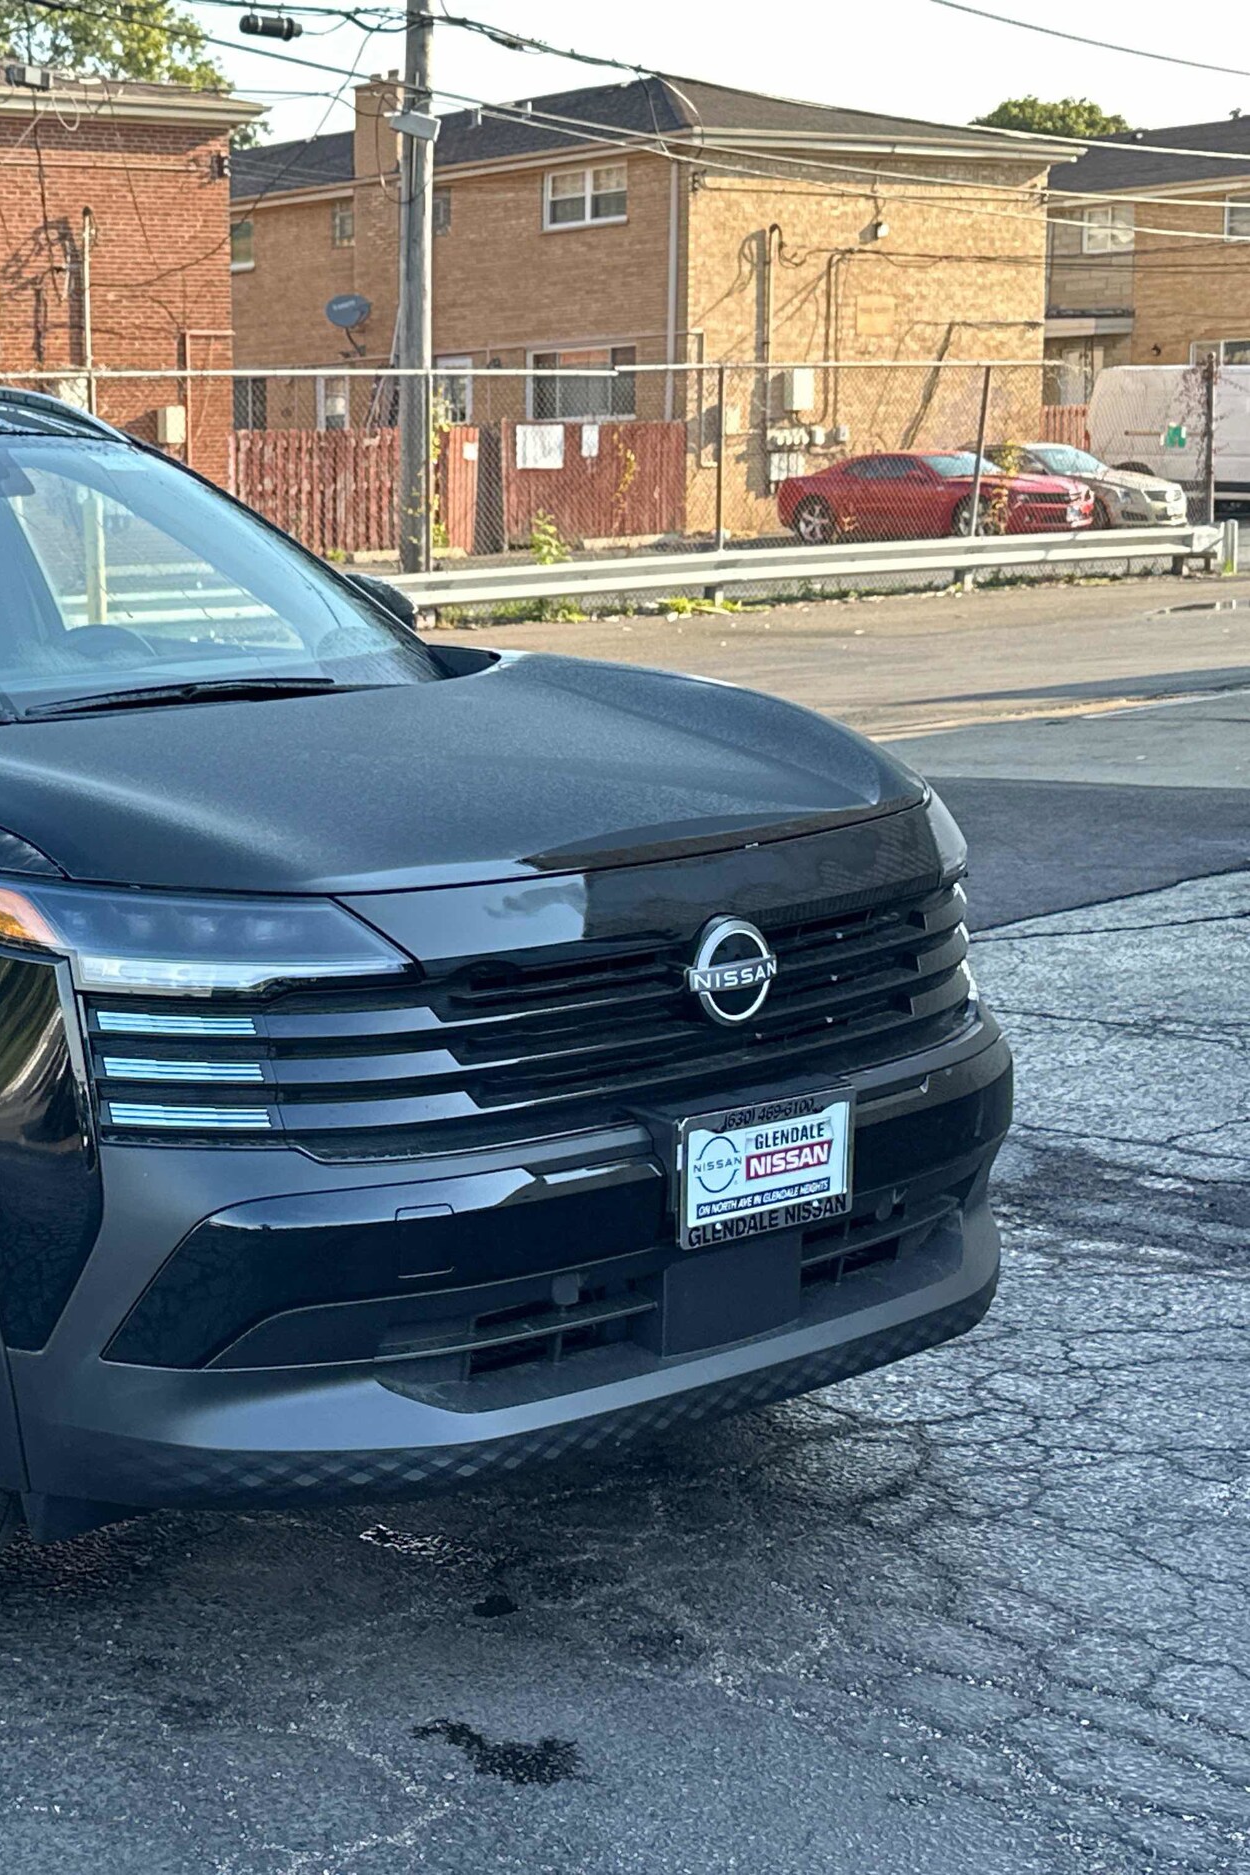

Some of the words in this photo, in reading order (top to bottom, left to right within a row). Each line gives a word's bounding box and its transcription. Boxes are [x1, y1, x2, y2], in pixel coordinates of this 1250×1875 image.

[693, 960, 777, 989] NISSAN
[758, 1098, 815, 1121] 469-6100
[754, 1121, 825, 1150] GLENDALE
[693, 1155, 743, 1174] NISSAN
[750, 1143, 829, 1177] NISSAN
[711, 1200, 737, 1213] NORTH
[738, 1197, 752, 1208] AVE
[753, 1195, 762, 1204] IN
[762, 1186, 799, 1203] GLENDALE
[799, 1181, 829, 1195] HEIGHTS
[687, 1209, 779, 1247] GLENDALE
[784, 1193, 847, 1225] NISSAN
